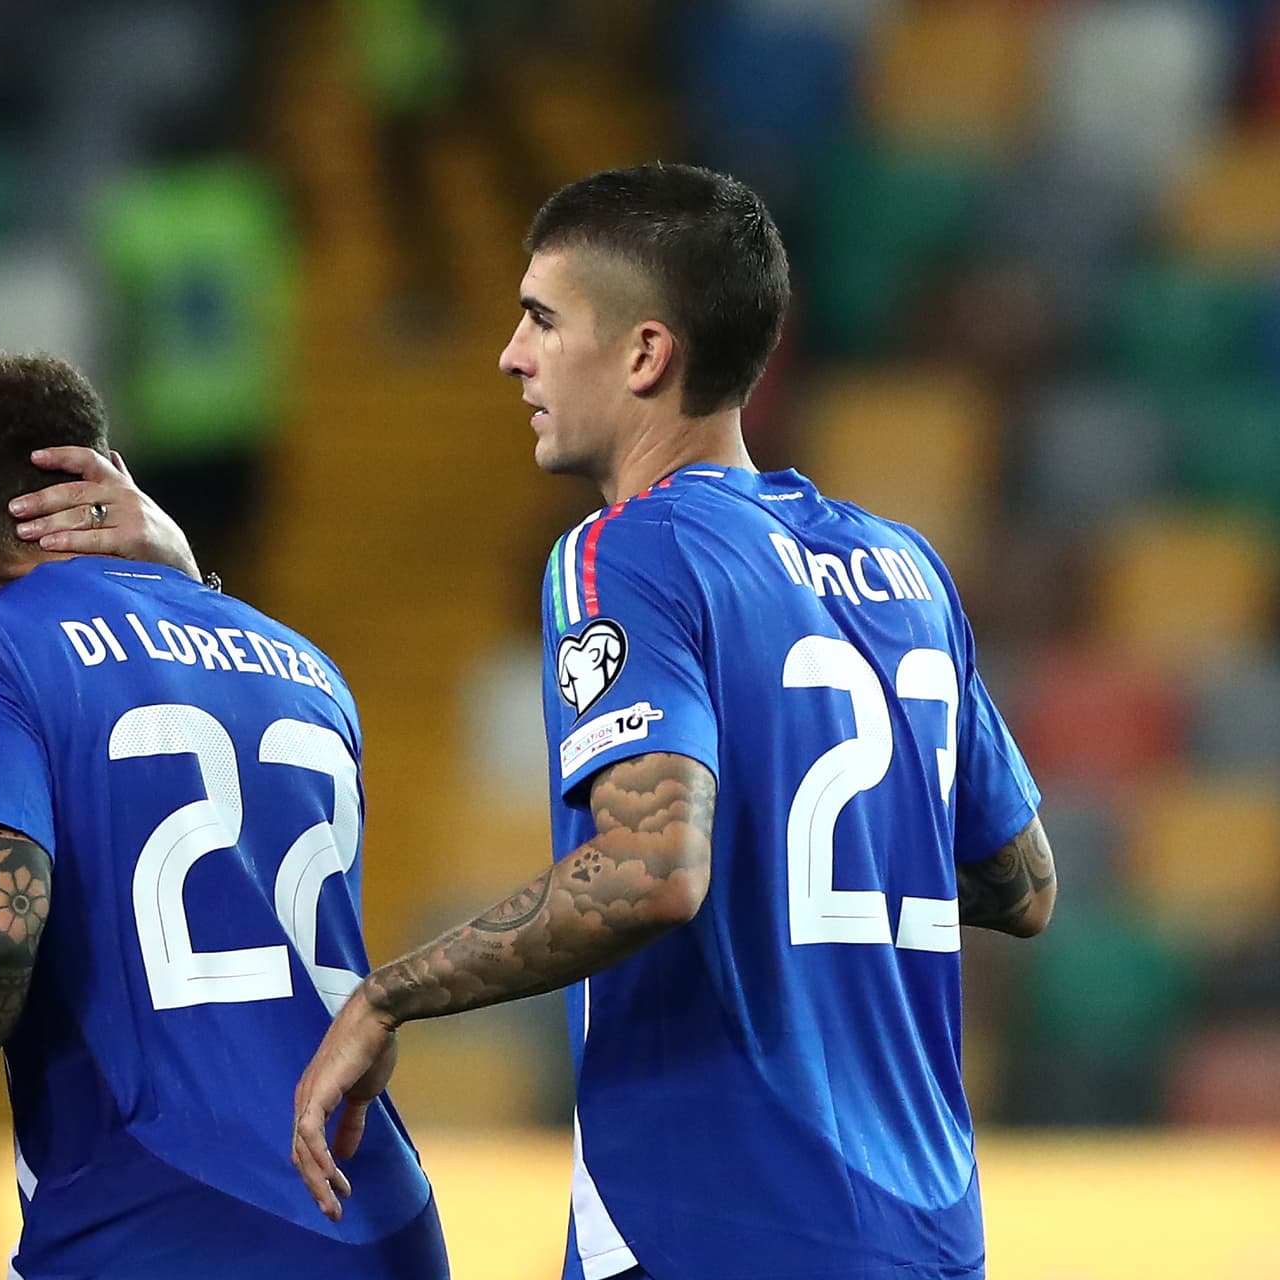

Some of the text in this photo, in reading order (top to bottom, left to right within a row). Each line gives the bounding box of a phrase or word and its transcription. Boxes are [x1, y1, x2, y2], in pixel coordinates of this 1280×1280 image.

[59, 612, 334, 696] DI LORENZO
[108, 703, 371, 1018] 22
